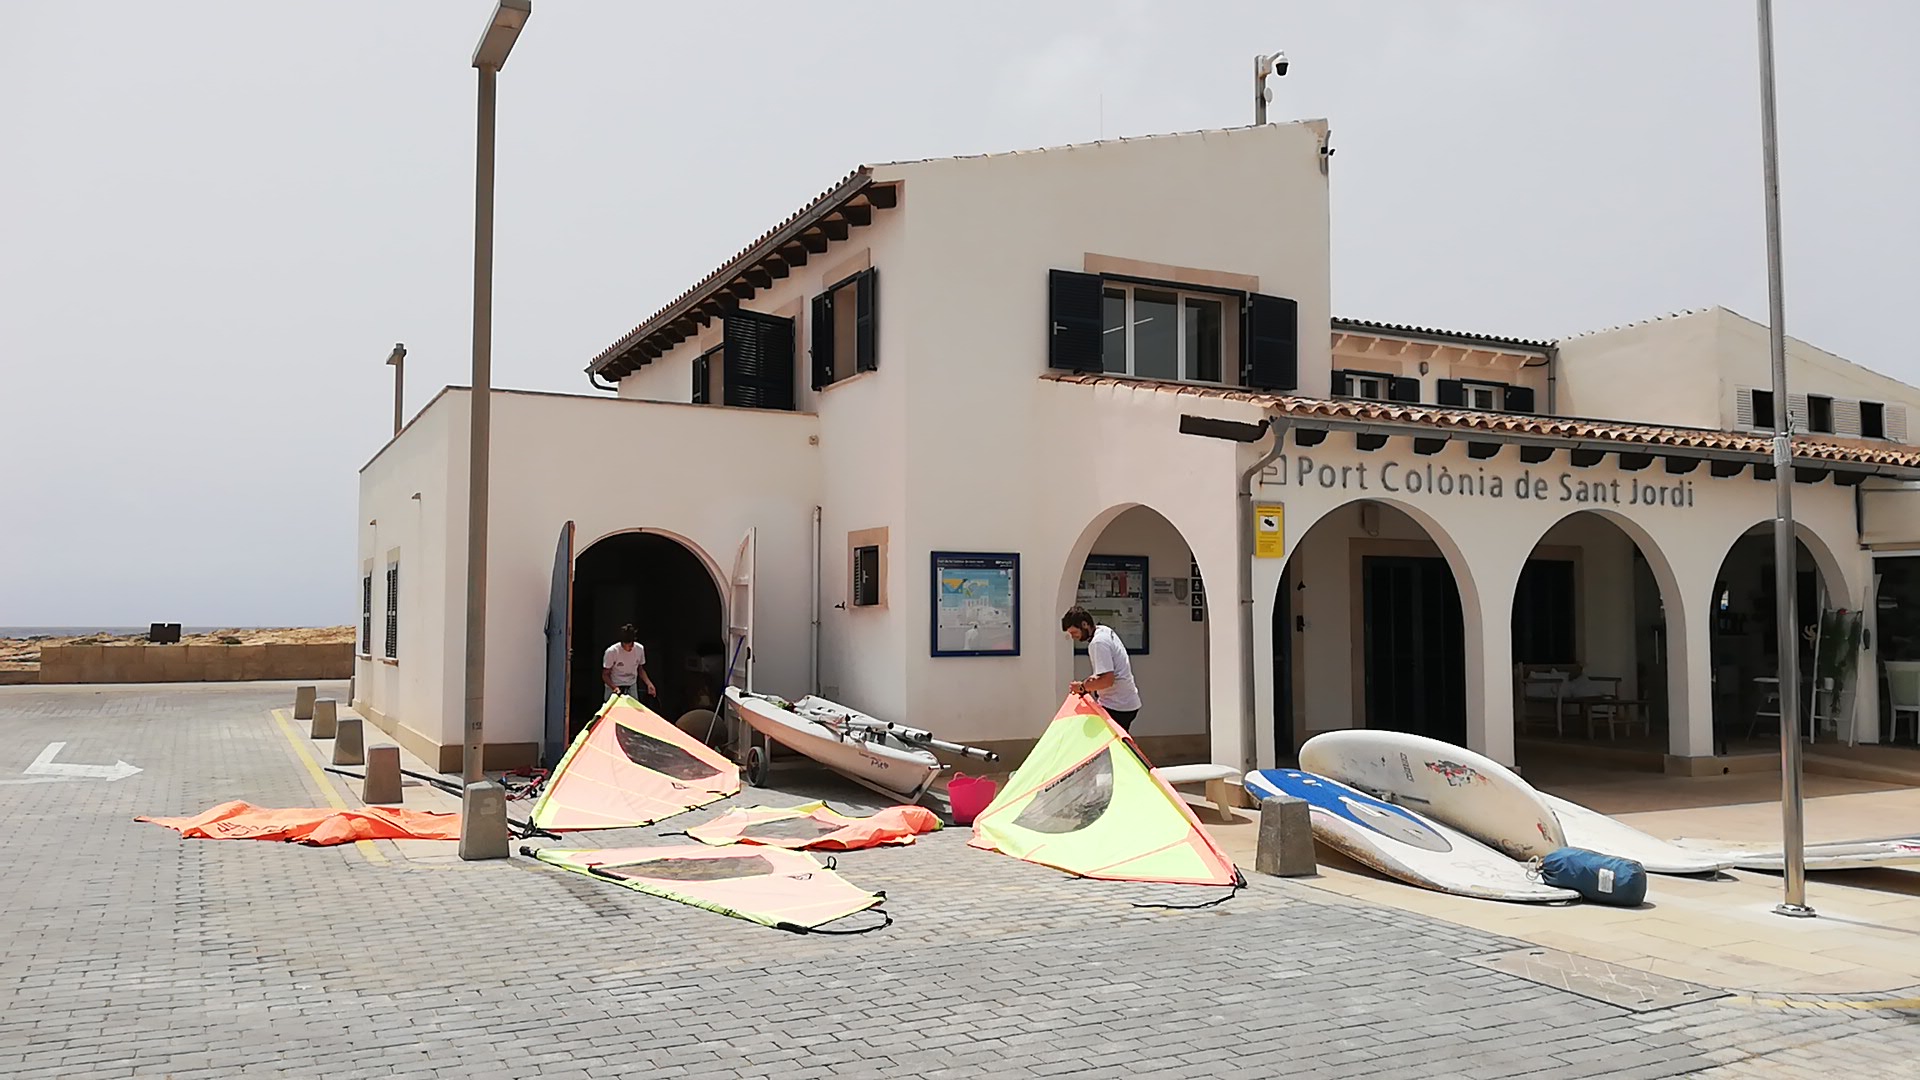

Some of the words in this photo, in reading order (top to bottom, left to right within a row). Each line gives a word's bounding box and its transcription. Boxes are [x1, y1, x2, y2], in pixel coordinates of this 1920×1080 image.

[1298, 456, 1368, 490] Port
[1380, 461, 1503, 498] Colònia
[1515, 470, 1549, 501] de
[1560, 473, 1621, 504] Sant
[1629, 478, 1695, 507] Jordi
